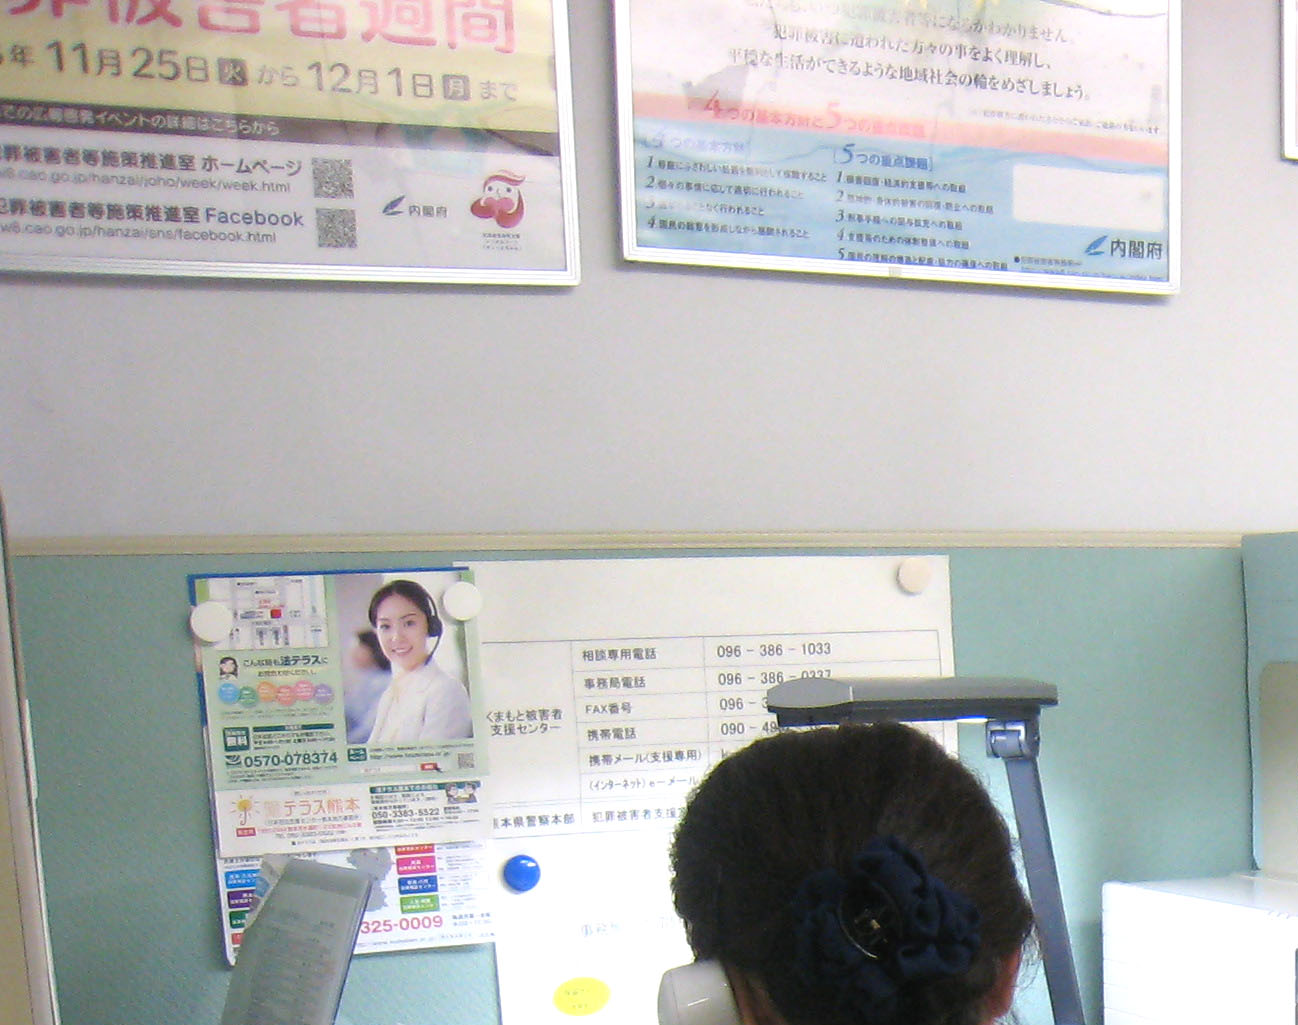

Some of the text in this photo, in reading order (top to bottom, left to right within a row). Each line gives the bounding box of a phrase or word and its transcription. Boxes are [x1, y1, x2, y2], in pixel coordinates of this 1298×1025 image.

[202, 154, 302, 177] ホームページ
[205, 206, 304, 227] Facebook
[408, 204, 448, 218] 内閣府
[1110, 238, 1163, 259] 内閣府
[582, 647, 657, 662] 相談専用電話
[584, 677, 647, 690] 事務局電話
[485, 708, 564, 723] くまもと被害者
[585, 702, 632, 715] FAX番号
[490, 723, 562, 737] 支援センター
[587, 727, 637, 742] 携帯電話
[244, 752, 338, 768] 0570-078374
[360, 915, 443, 935] 325-0009
